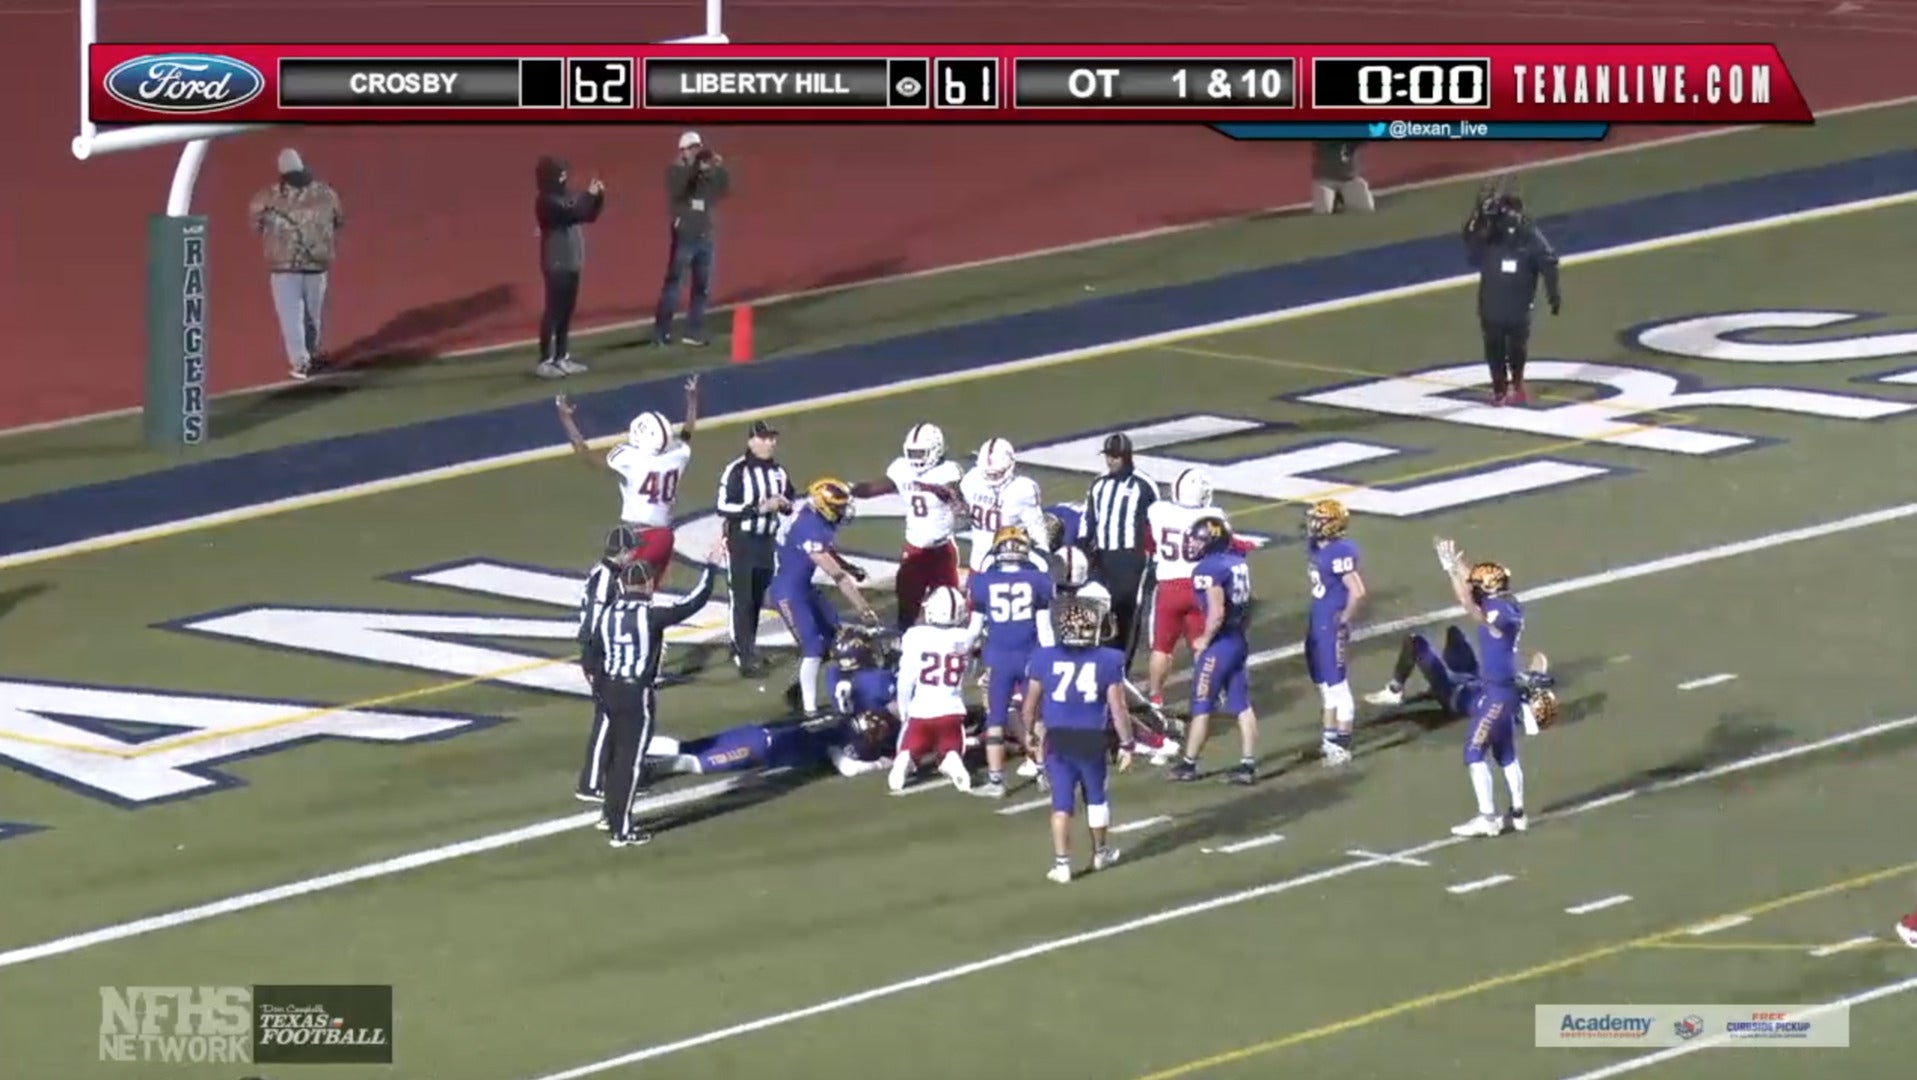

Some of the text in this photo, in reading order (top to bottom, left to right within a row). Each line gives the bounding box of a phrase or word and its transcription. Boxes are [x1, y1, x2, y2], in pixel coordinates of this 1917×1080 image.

[183, 236, 205, 444] RANGERS
[638, 467, 679, 504] 40
[911, 495, 929, 518] 8
[988, 582, 1033, 623] 52
[614, 610, 633, 643] L
[919, 651, 966, 687] 28
[1051, 661, 1099, 703] 74
